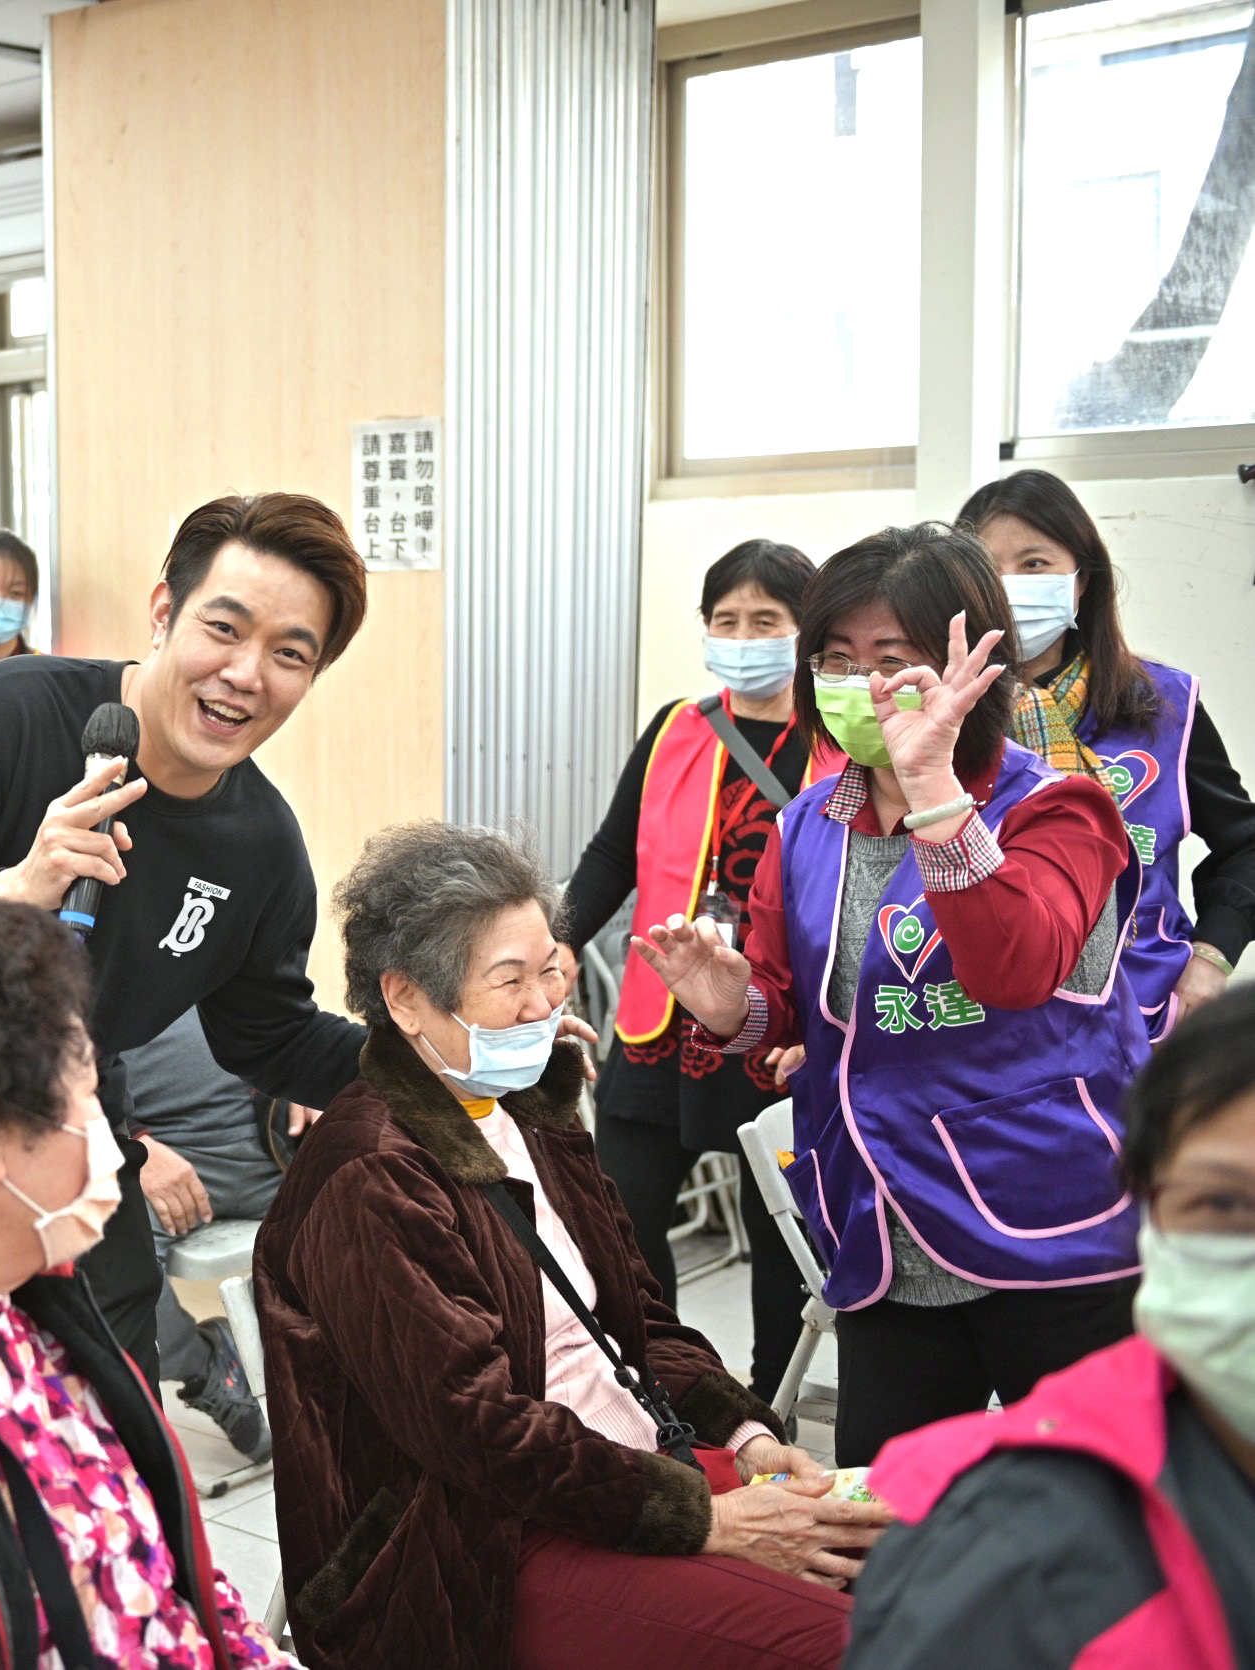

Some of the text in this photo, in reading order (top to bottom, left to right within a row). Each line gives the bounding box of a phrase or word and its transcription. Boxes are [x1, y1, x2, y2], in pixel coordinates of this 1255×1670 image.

[362, 433, 381, 560] 請尊重台上
[193, 881, 225, 897] FASHION
[874, 979, 986, 1034] 永達
